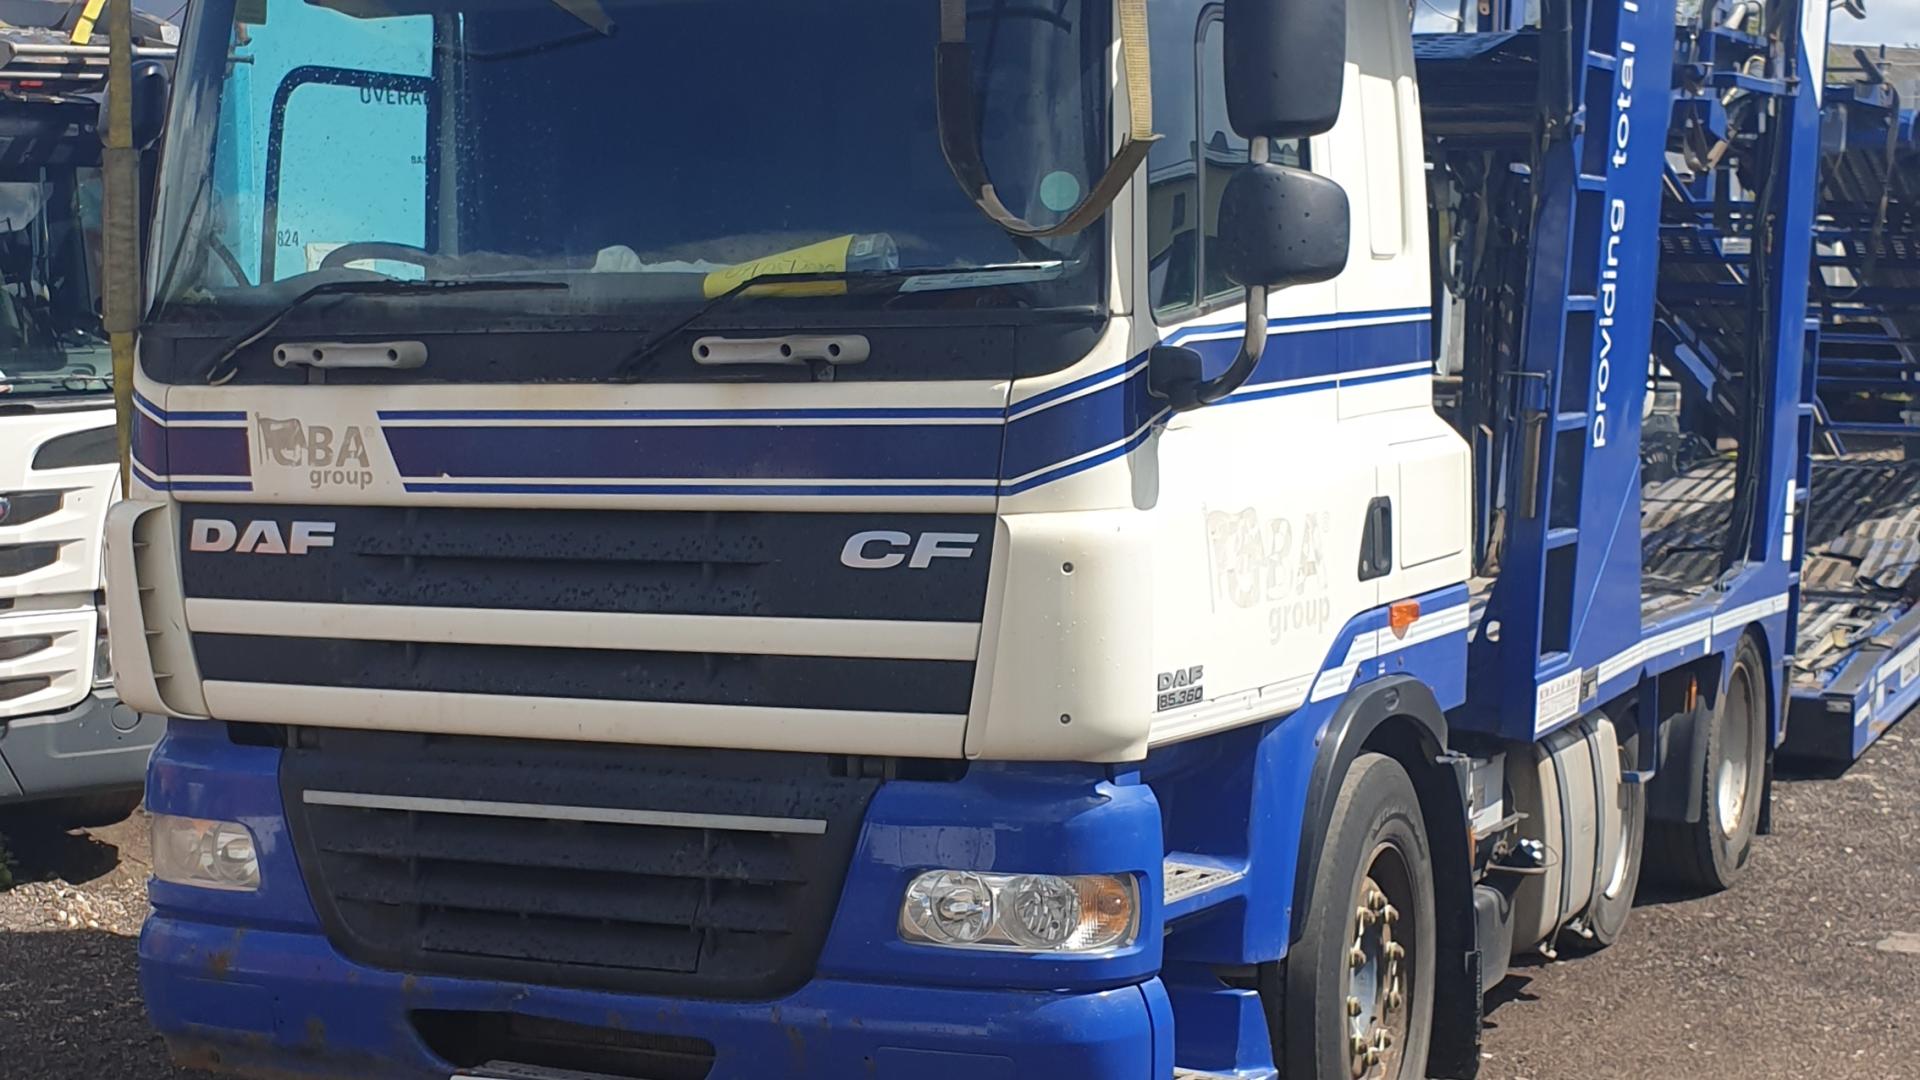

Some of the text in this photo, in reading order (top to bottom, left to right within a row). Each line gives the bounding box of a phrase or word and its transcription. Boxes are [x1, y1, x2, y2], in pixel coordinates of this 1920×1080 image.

[361, 86, 428, 105] OVERA
[1593, 199, 1626, 448] providing
[1612, 41, 1636, 168] total
[309, 469, 373, 490] group
[190, 518, 336, 554] DAF
[840, 530, 979, 569] CF
[1268, 597, 1331, 646] group
[1157, 664, 1204, 692] DAF
